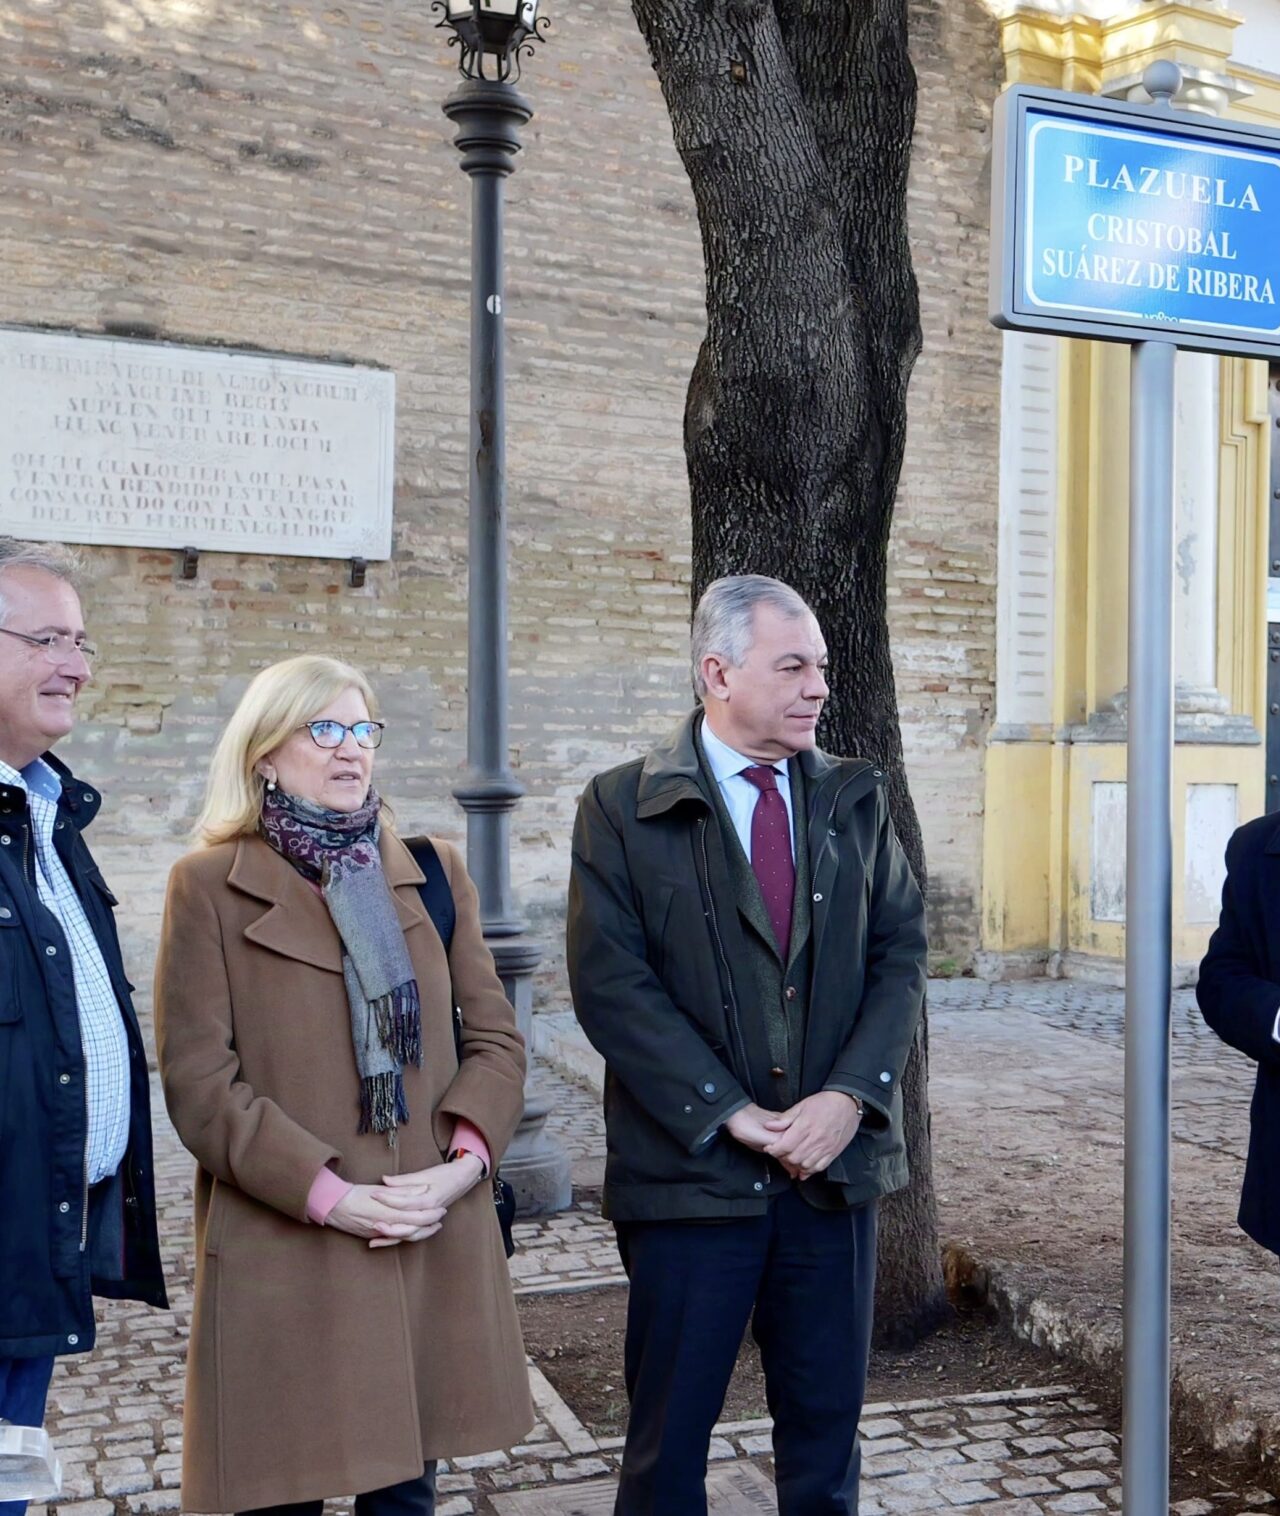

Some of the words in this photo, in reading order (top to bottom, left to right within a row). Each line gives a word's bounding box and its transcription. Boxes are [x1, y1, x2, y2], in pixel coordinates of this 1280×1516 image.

[1063, 154, 1261, 212] PLAZUELA
[1087, 212, 1237, 260] CRISTOBAL
[1042, 244, 1142, 287] SUÁREZ
[1147, 262, 1180, 292] DE
[1186, 268, 1275, 305] RIBERA
[68, 397, 159, 419] SUPLEX
[222, 410, 320, 433] TRANSIS
[225, 392, 289, 412] REGIS
[54, 414, 122, 435] HUNC
[132, 422, 256, 446] VENERARE
[263, 433, 331, 452] LOCUM
[14, 469, 110, 490] VENERA
[120, 477, 220, 498] RENDIDO
[227, 486, 280, 502] ESTE
[288, 490, 354, 508] LUGAR
[97, 458, 243, 484] CUALQUIERA
[249, 471, 290, 487] QUE
[10, 487, 164, 510] CONSAGRADO
[174, 498, 213, 514] CON
[224, 502, 250, 517] LA
[264, 505, 352, 523] SANGRE
[31, 505, 77, 522] DEL
[87, 509, 131, 525] REY
[146, 513, 334, 537] HERMENEGILDO
